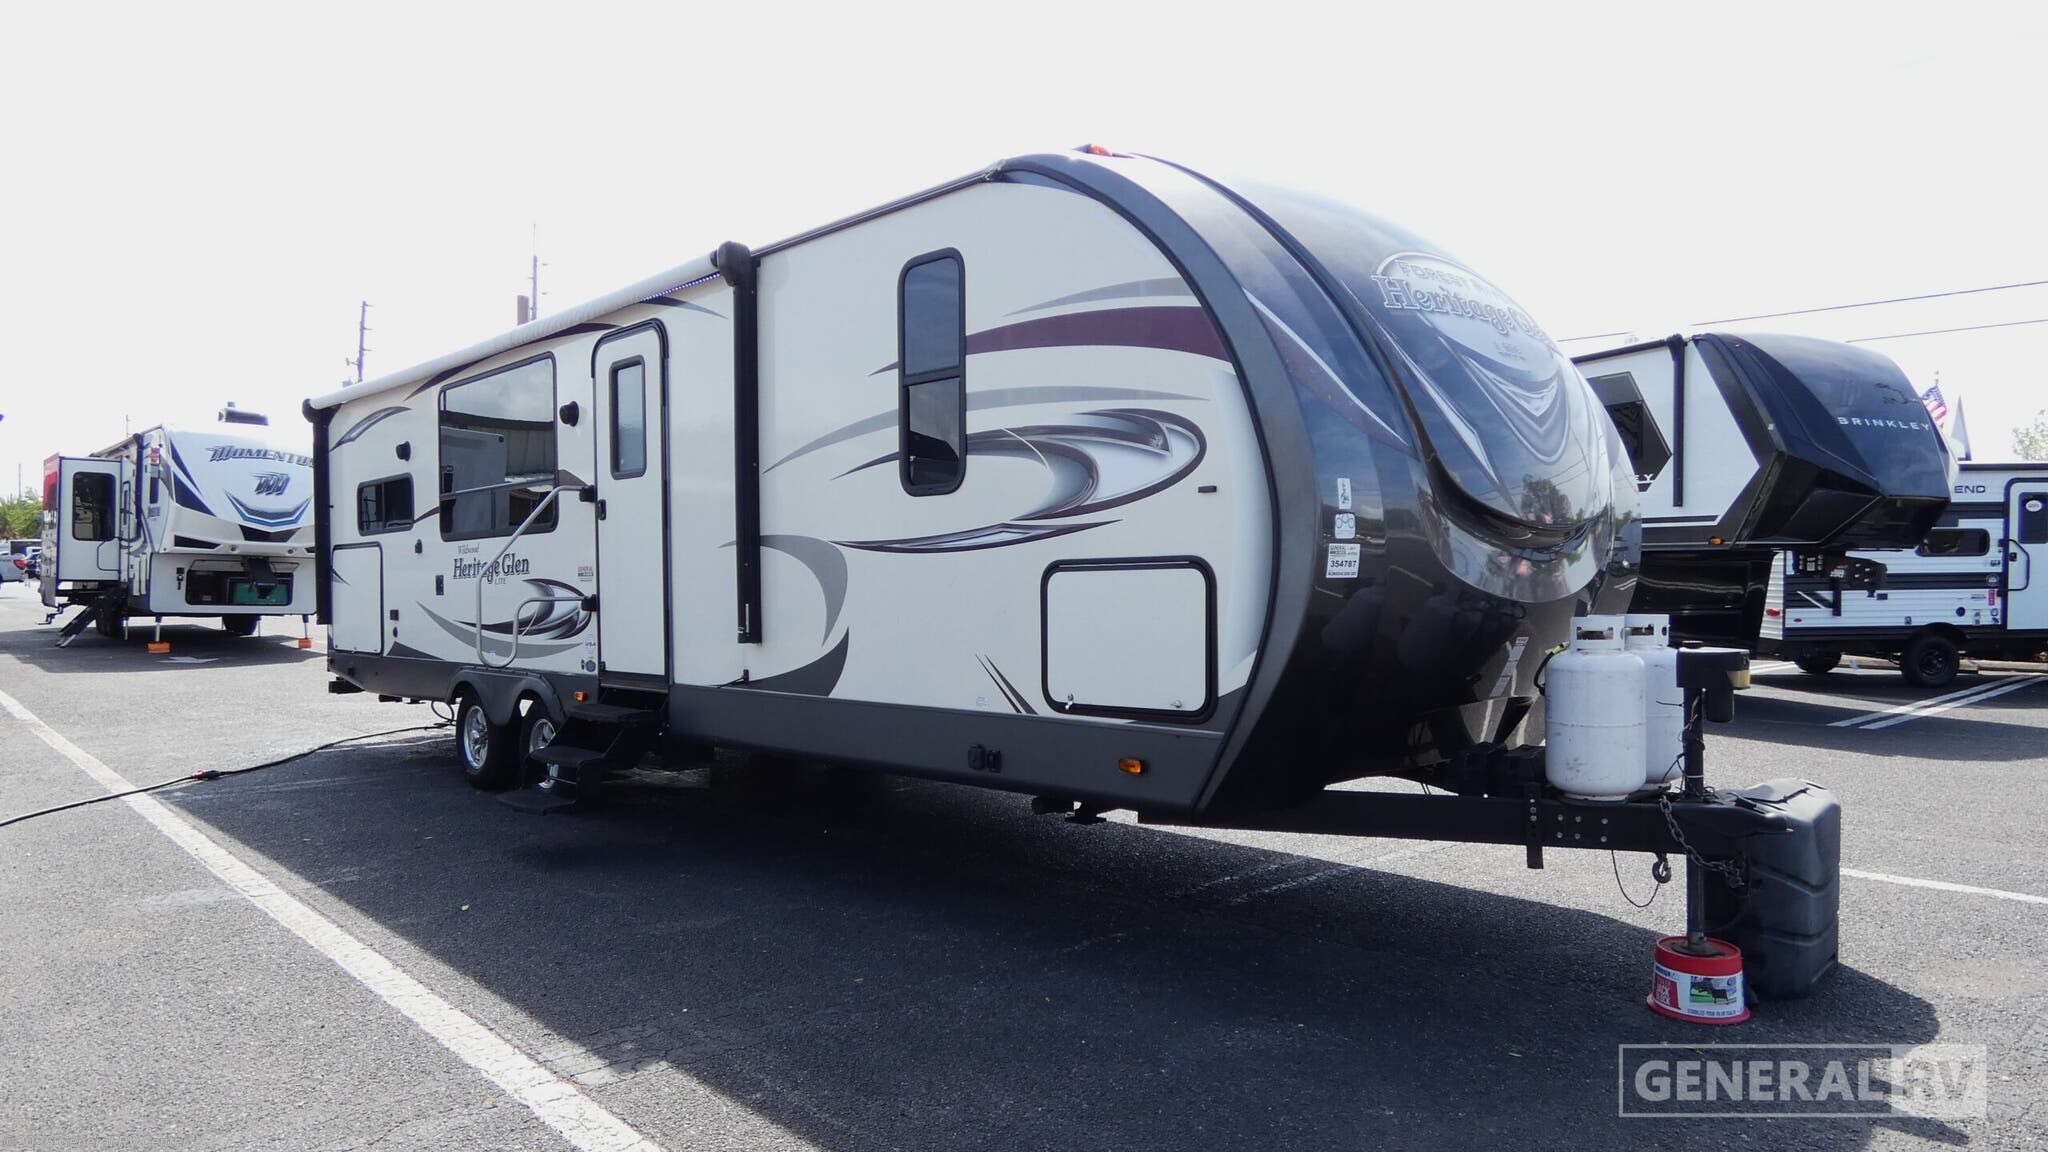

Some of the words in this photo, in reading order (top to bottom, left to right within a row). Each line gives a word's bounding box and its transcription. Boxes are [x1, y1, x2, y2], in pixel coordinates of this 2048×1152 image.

[1837, 416, 1930, 431] BRINKLEY
[502, 552, 530, 577] Glen
[1329, 560, 1357, 568] 354787
